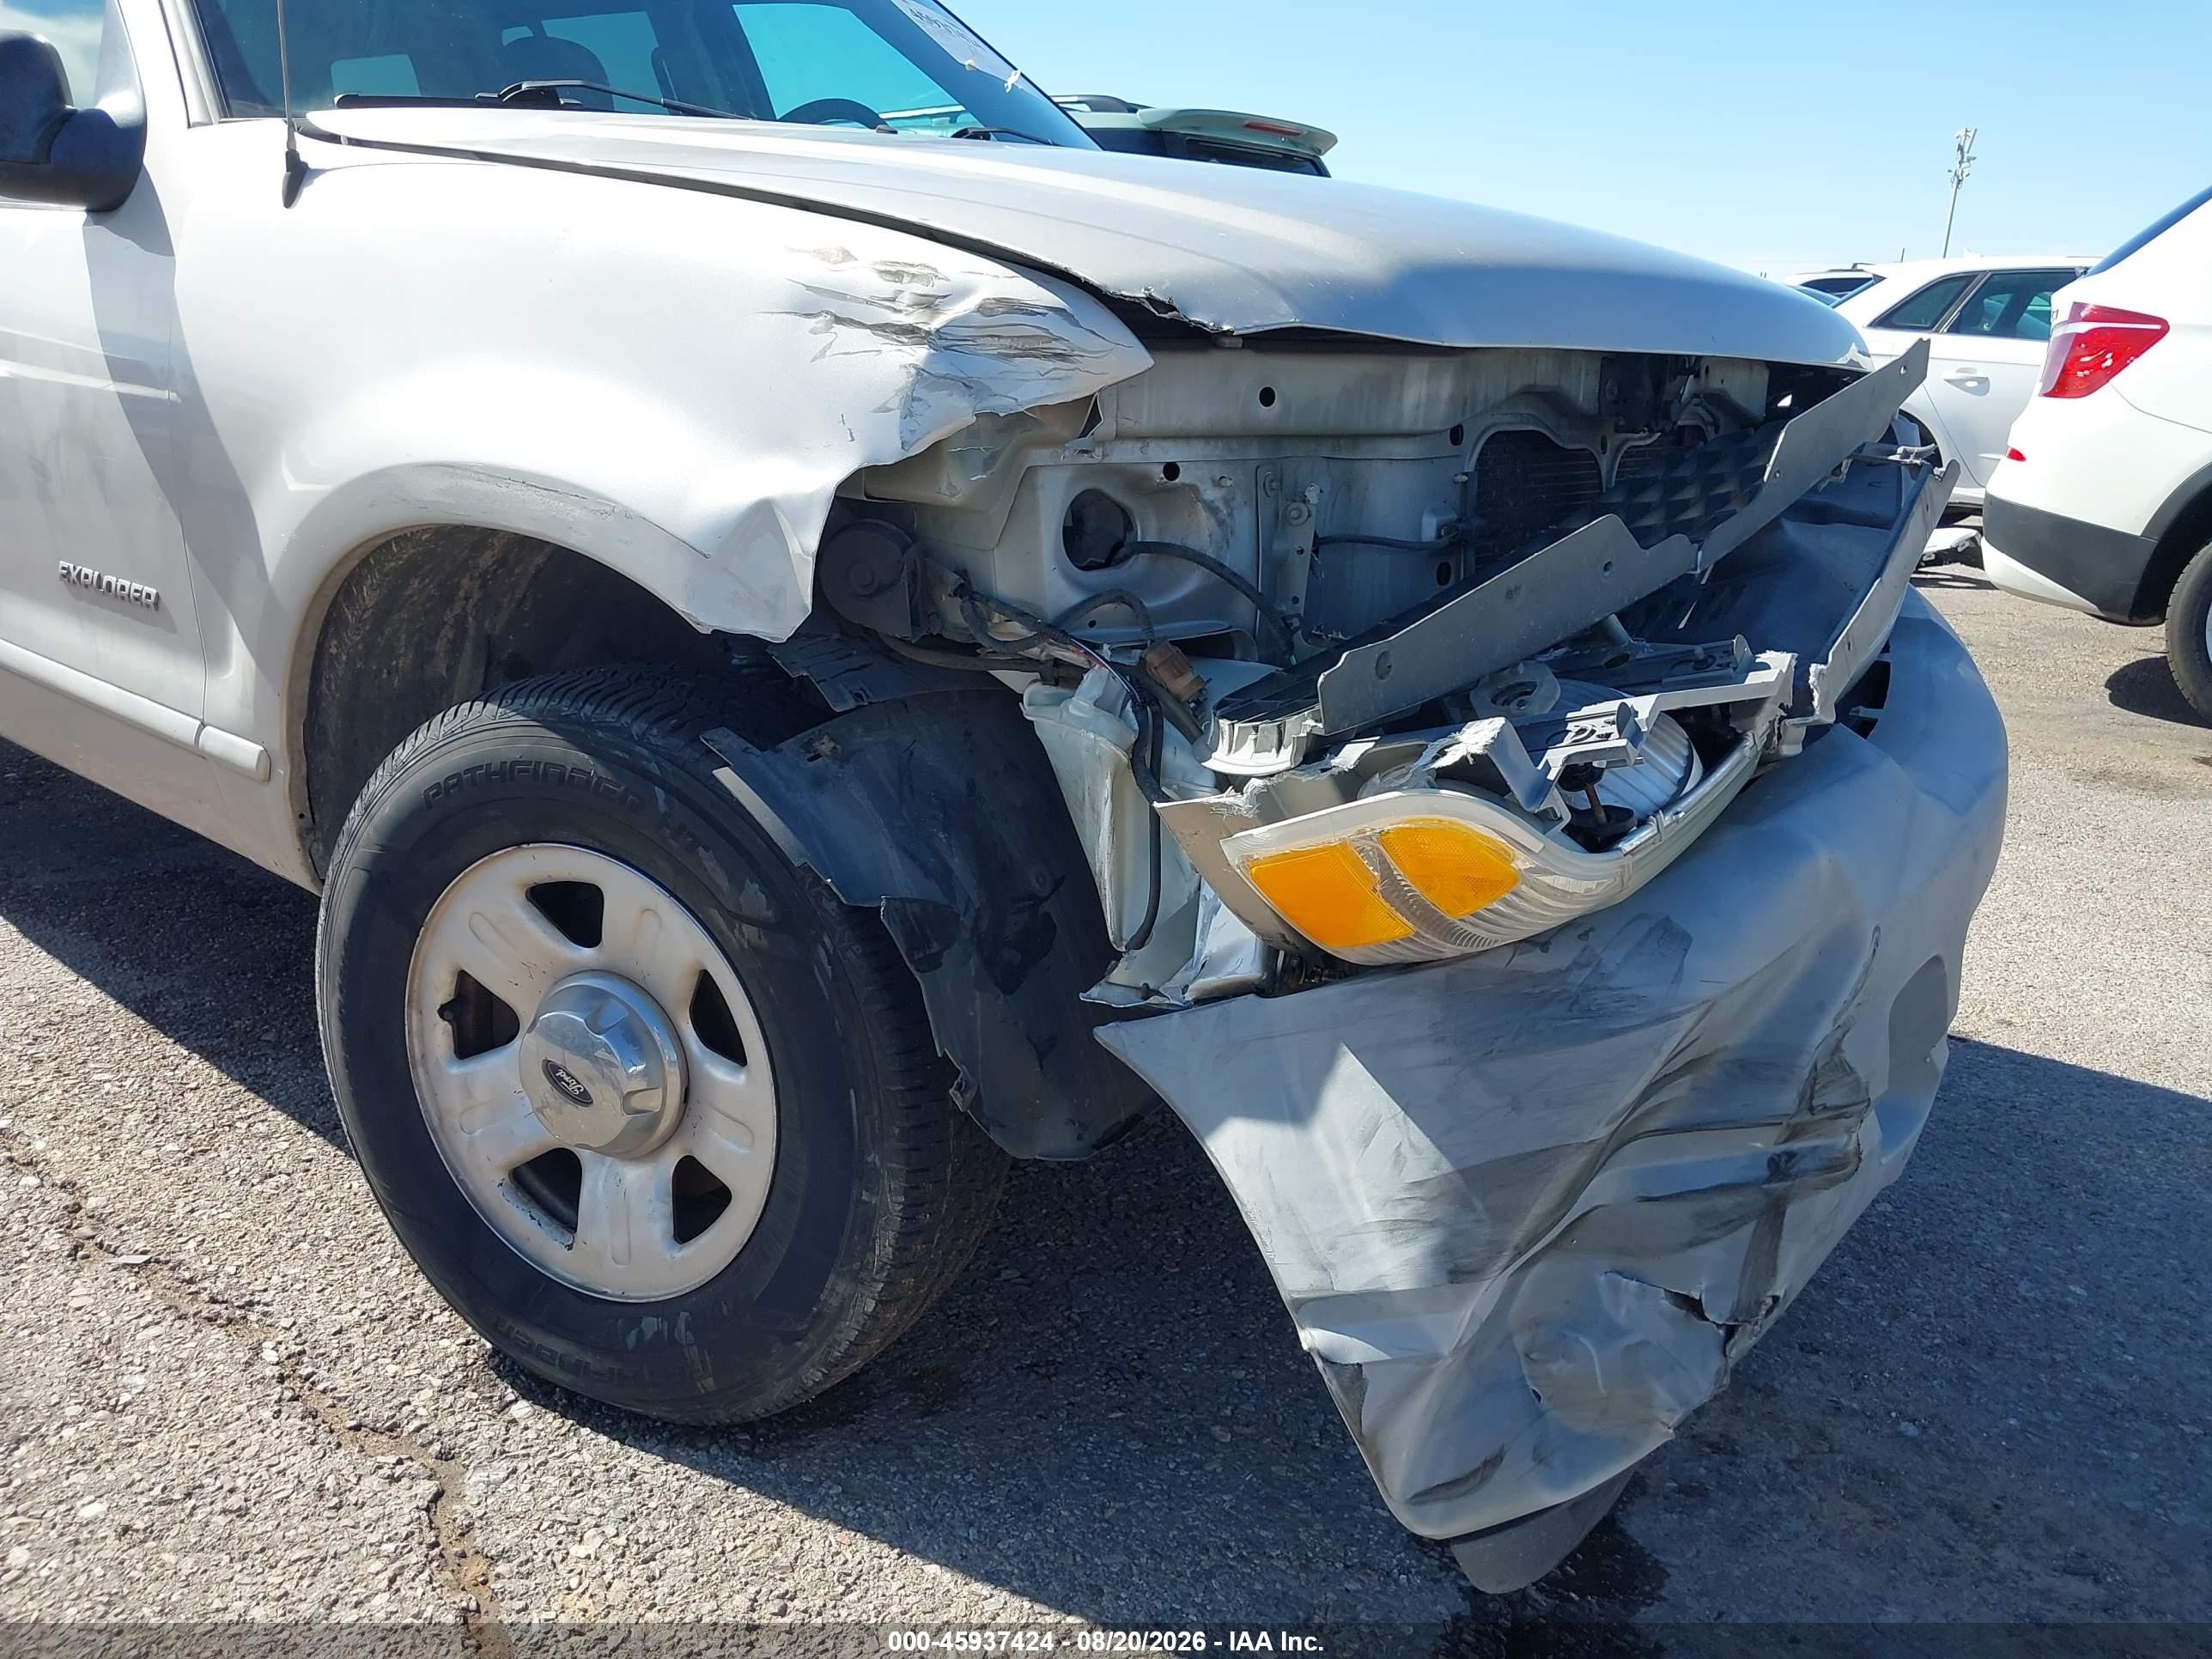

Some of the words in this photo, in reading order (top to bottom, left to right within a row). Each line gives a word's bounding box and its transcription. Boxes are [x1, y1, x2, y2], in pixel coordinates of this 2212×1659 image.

[58, 561, 159, 611] EXPLORER
[422, 760, 647, 812] PATHFINDER
[555, 1069, 584, 1096] Ford
